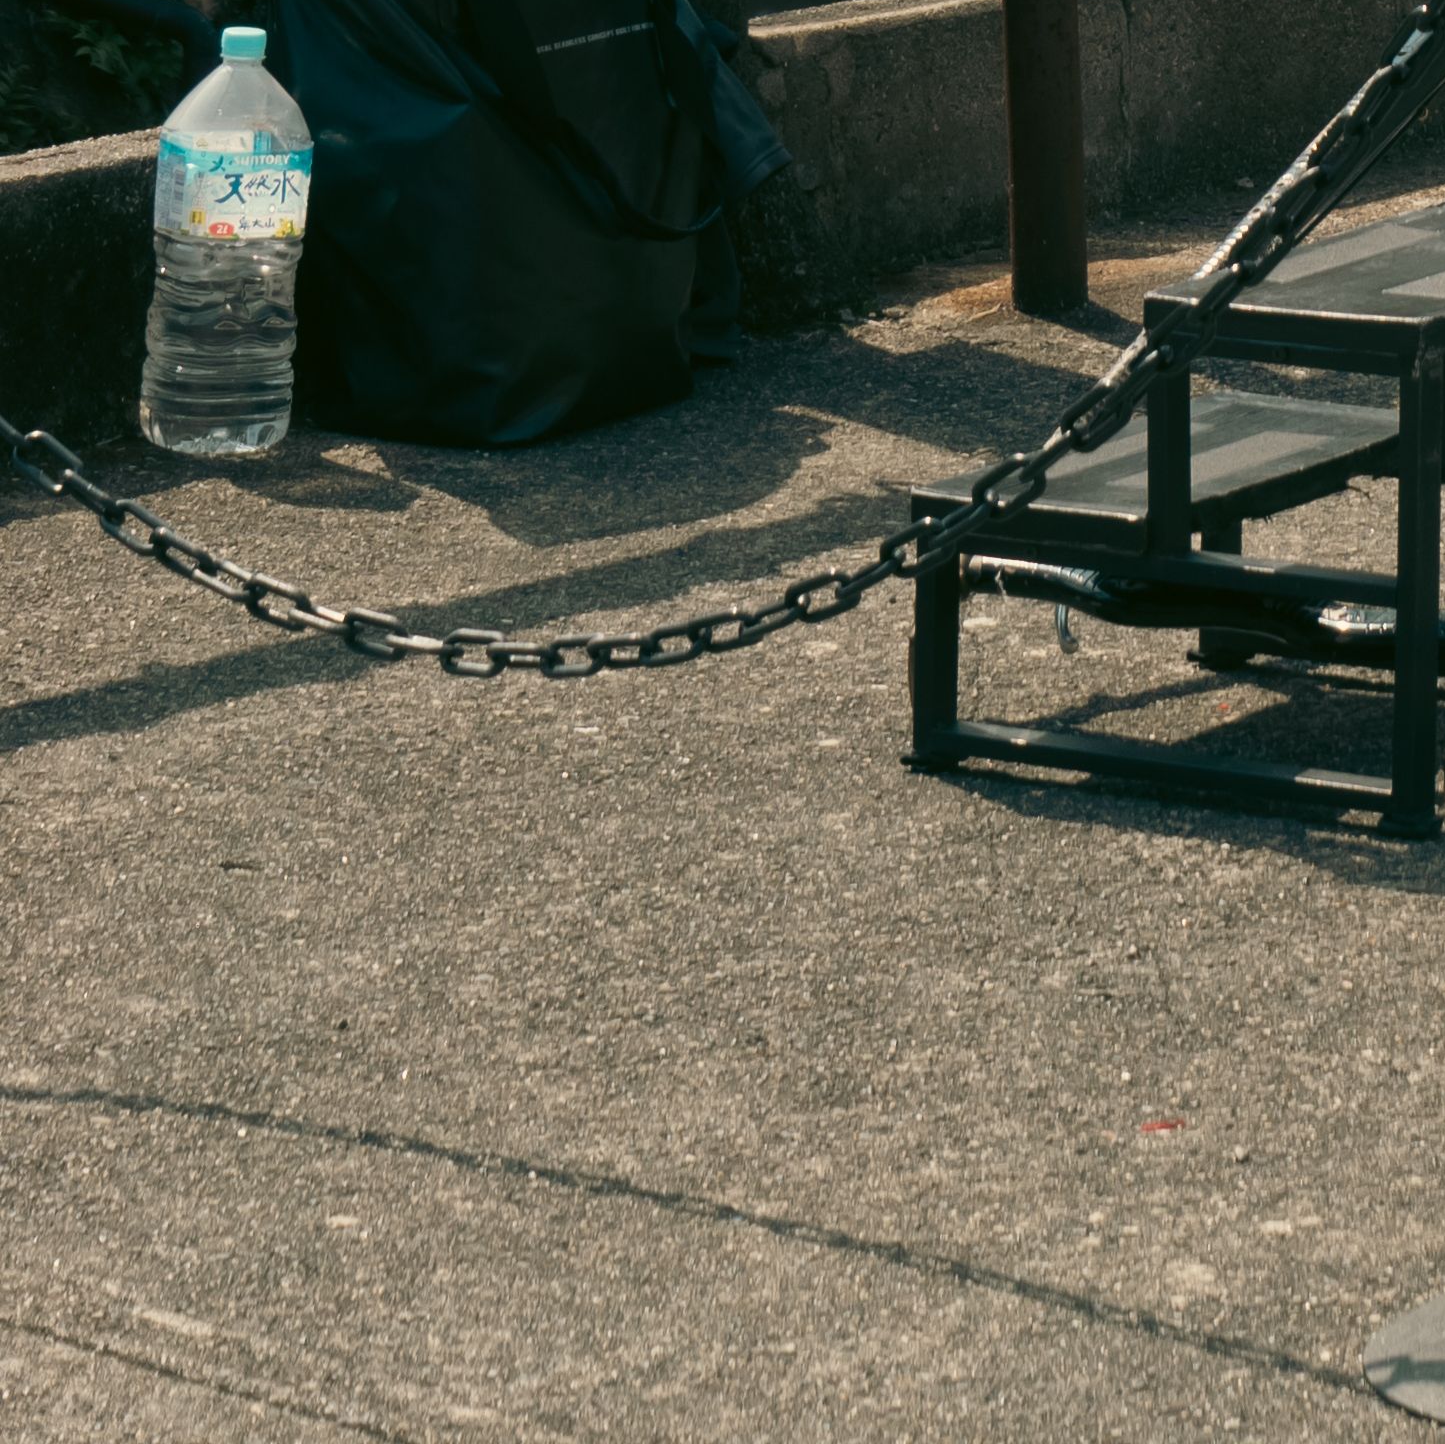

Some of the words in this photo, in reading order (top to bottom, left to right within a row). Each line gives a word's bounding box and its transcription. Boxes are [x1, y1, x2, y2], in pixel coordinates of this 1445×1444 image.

[234, 154, 290, 165] SUNTORY
[214, 170, 300, 204] 天然水
